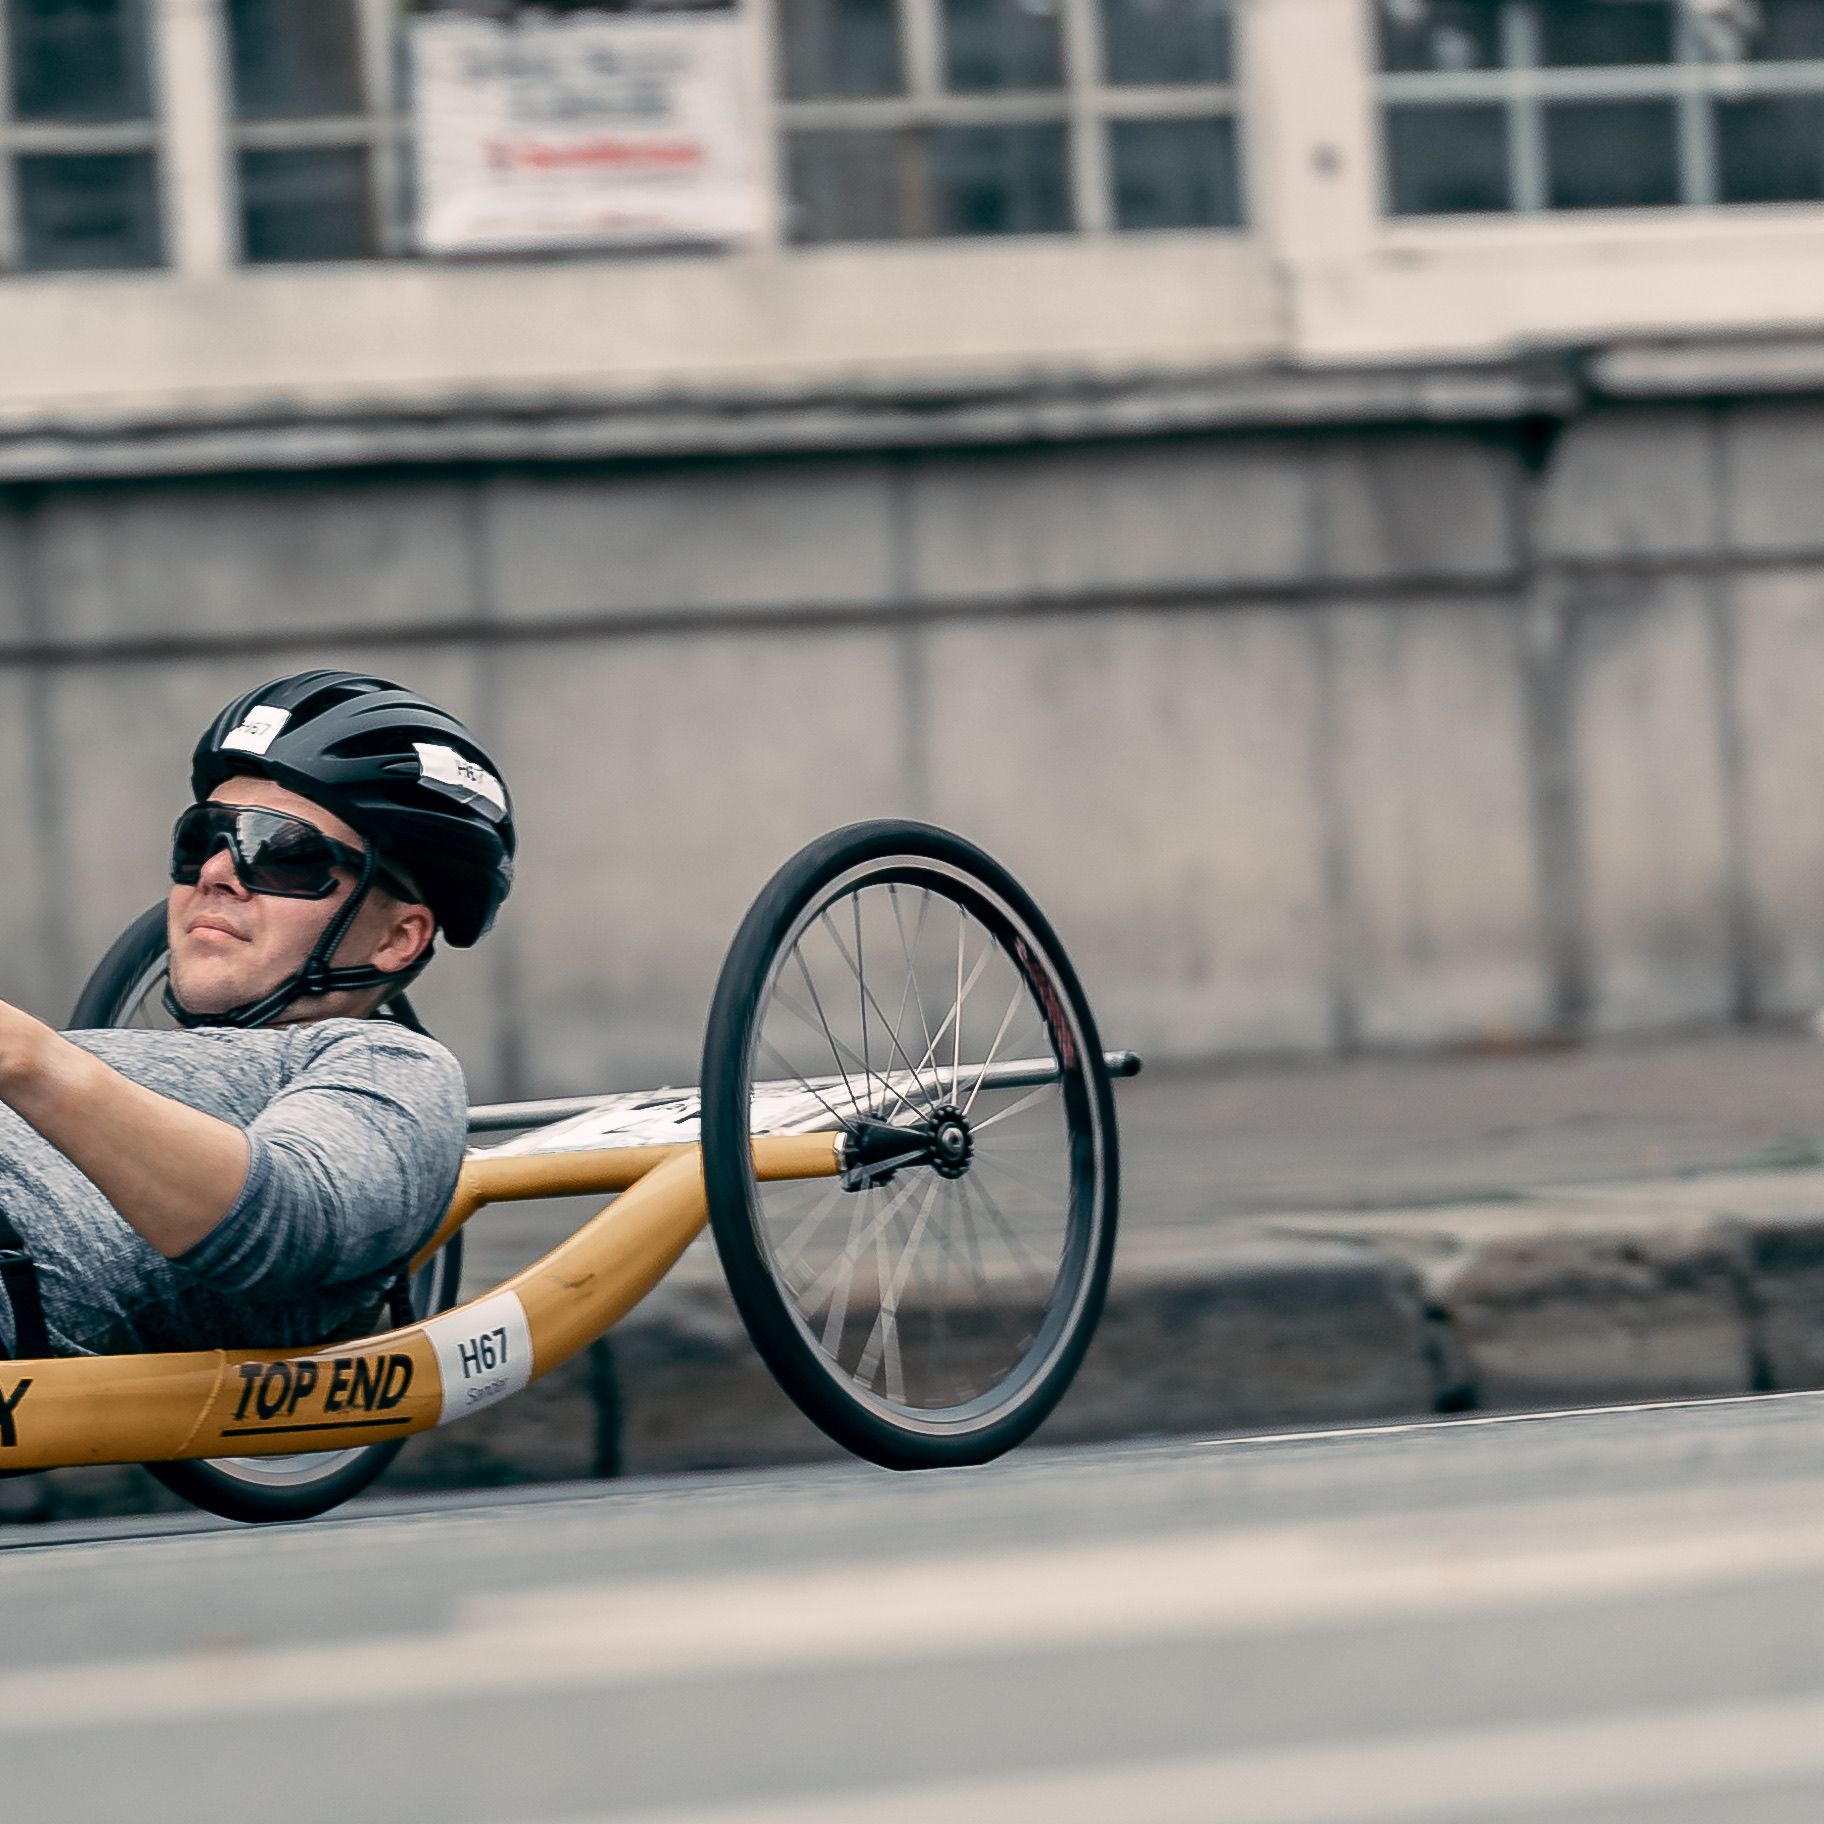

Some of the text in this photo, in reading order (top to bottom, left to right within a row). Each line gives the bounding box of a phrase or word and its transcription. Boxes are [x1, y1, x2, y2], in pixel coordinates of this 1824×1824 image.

[458, 1327, 507, 1379] H67
[233, 1353, 414, 1422] TOP END
